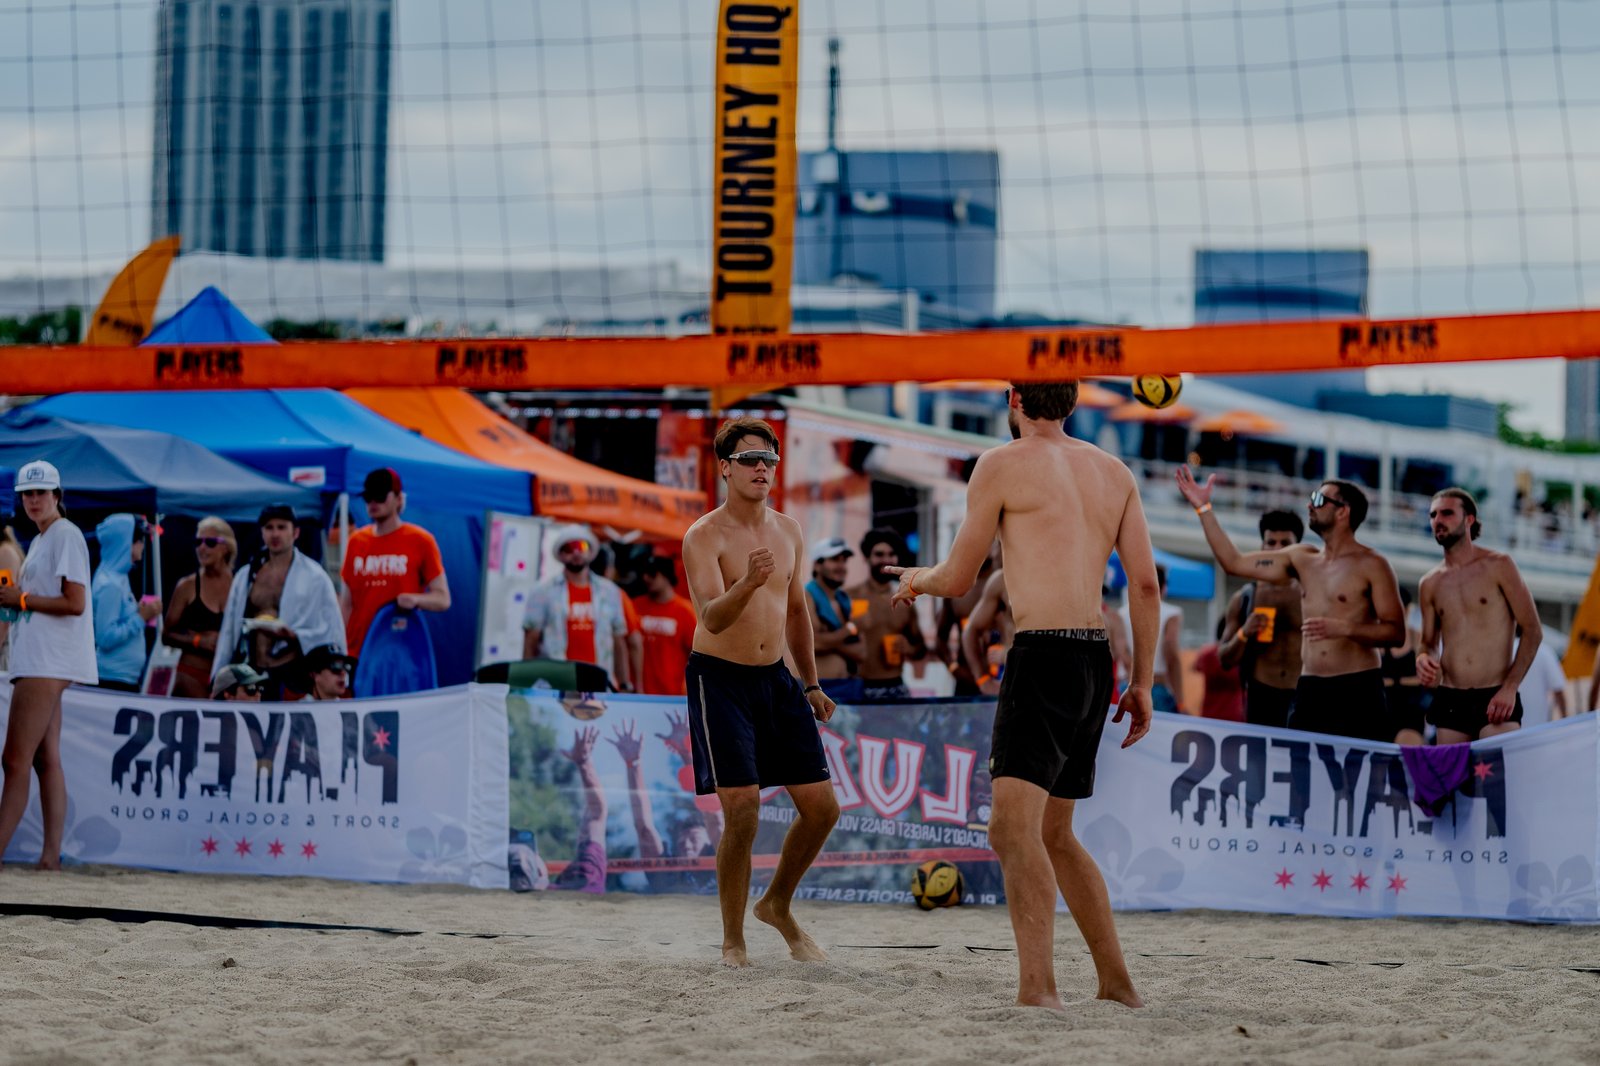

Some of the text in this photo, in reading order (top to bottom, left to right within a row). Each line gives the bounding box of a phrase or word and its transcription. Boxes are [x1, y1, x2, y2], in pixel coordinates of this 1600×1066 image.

[724, 4, 792, 66] HQ
[715, 84, 780, 303] TOURNEY
[353, 553, 408, 577] PLAYERS
